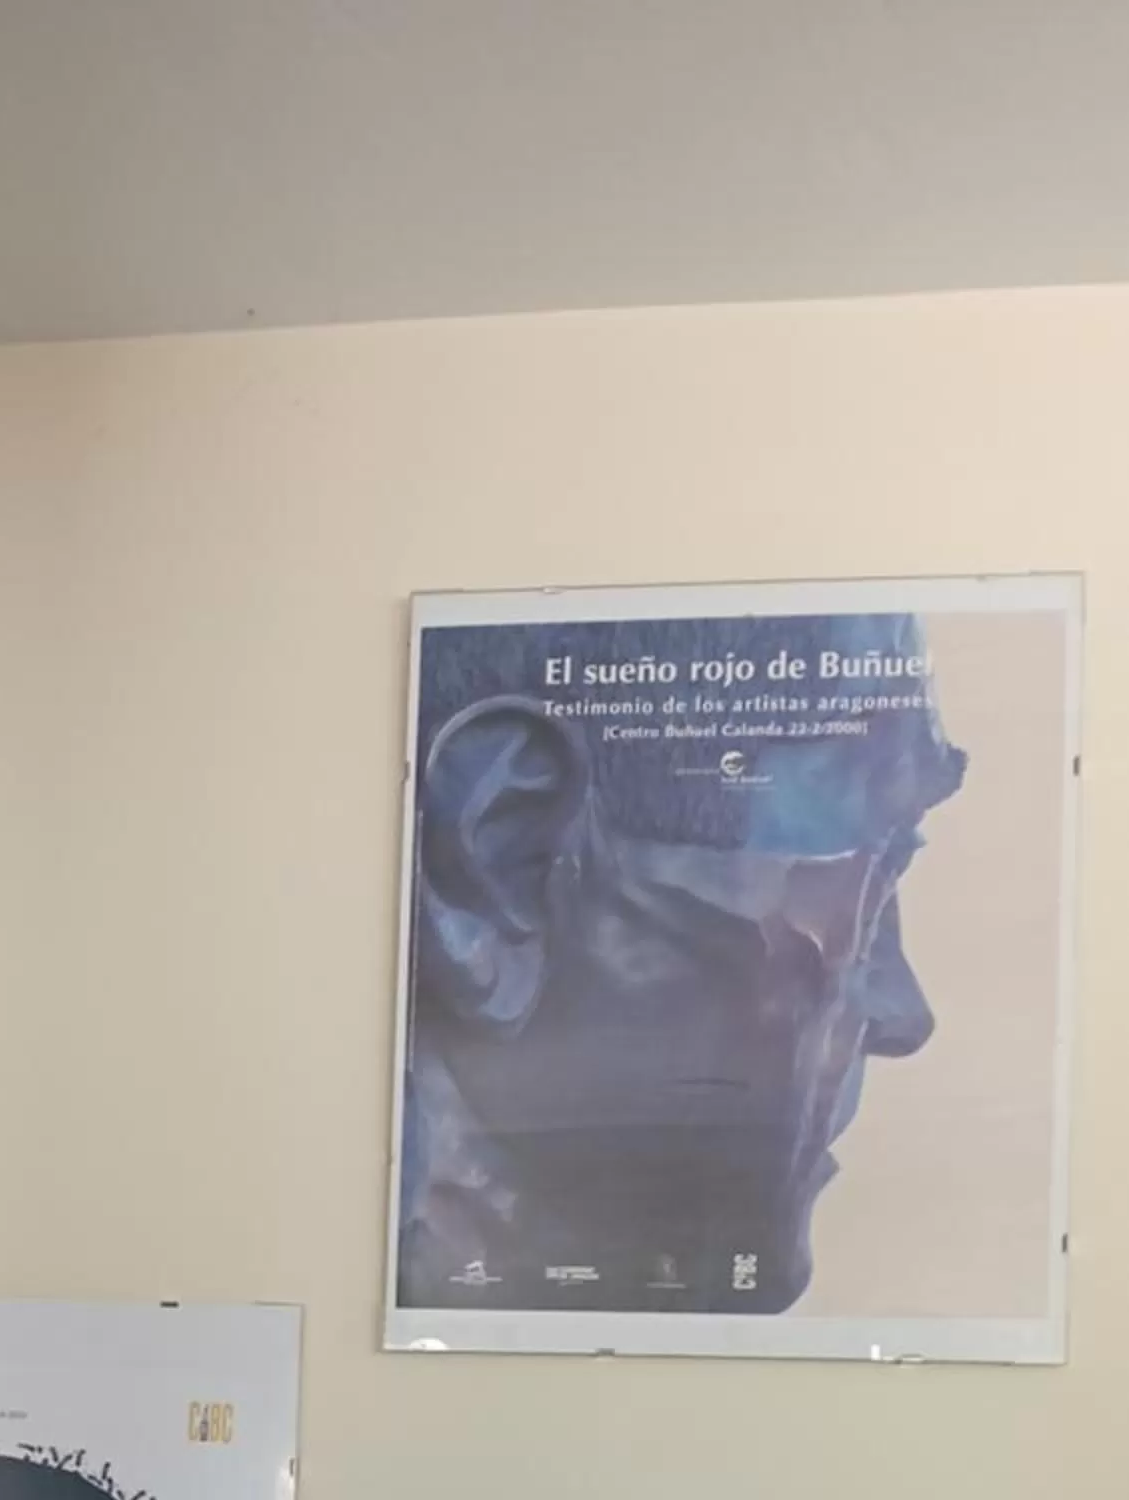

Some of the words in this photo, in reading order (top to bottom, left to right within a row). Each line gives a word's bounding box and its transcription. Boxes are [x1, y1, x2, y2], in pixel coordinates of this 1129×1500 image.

[545, 657, 570, 685] El
[583, 655, 679, 685] sueño
[690, 655, 756, 687] rojo
[767, 650, 807, 679] de
[543, 697, 654, 716] Testimonio
[662, 697, 688, 714] de
[694, 695, 725, 713] los
[732, 695, 809, 712] artistas
[664, 722, 717, 738] Buñuel
[721, 721, 784, 737] Calanda
